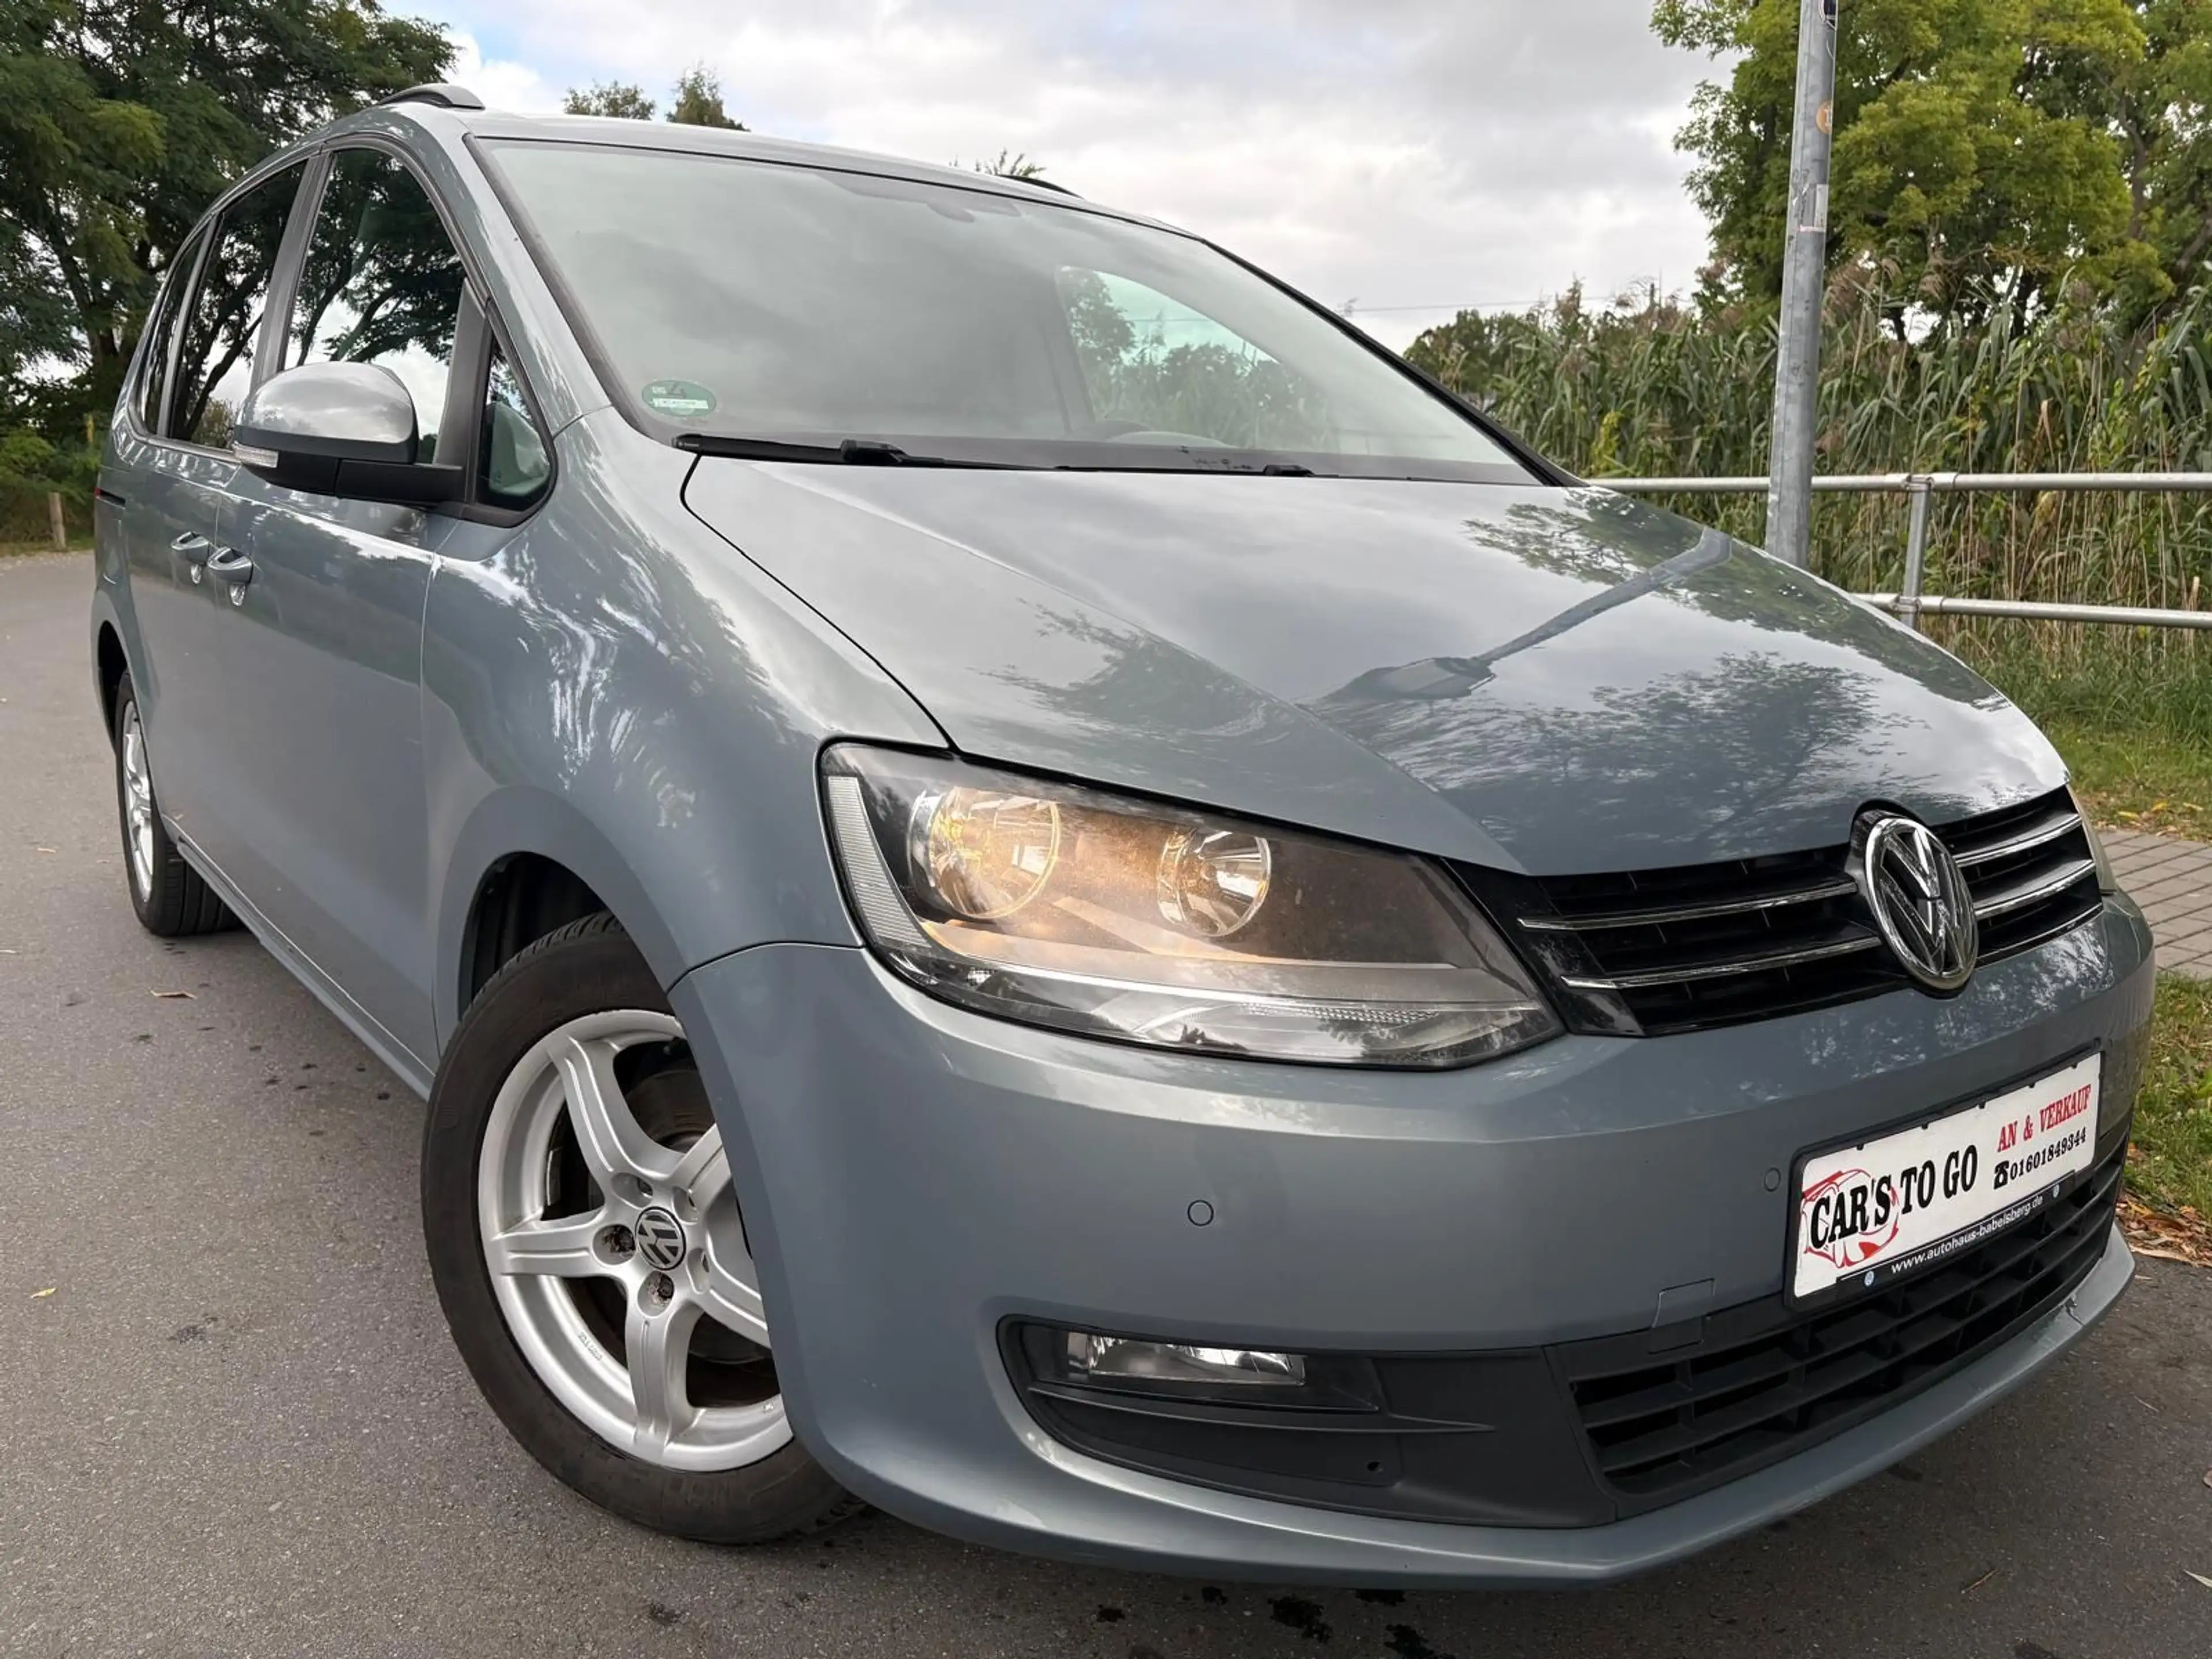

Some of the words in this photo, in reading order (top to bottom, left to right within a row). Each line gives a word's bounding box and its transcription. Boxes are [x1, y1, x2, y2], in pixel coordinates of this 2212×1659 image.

[1997, 1120, 2018, 1153] AN
[2023, 1115, 2033, 1141] &
[2039, 1084, 2092, 1132] VERKAUF
[2010, 1125, 2086, 1180] 01601849344
[1810, 1175, 1891, 1249] CAR'S
[1900, 1160, 1936, 1214] TO
[1943, 1144, 1978, 1199] GO
[1891, 1195, 2043, 1274] www.autohaus-babelsberg.de
